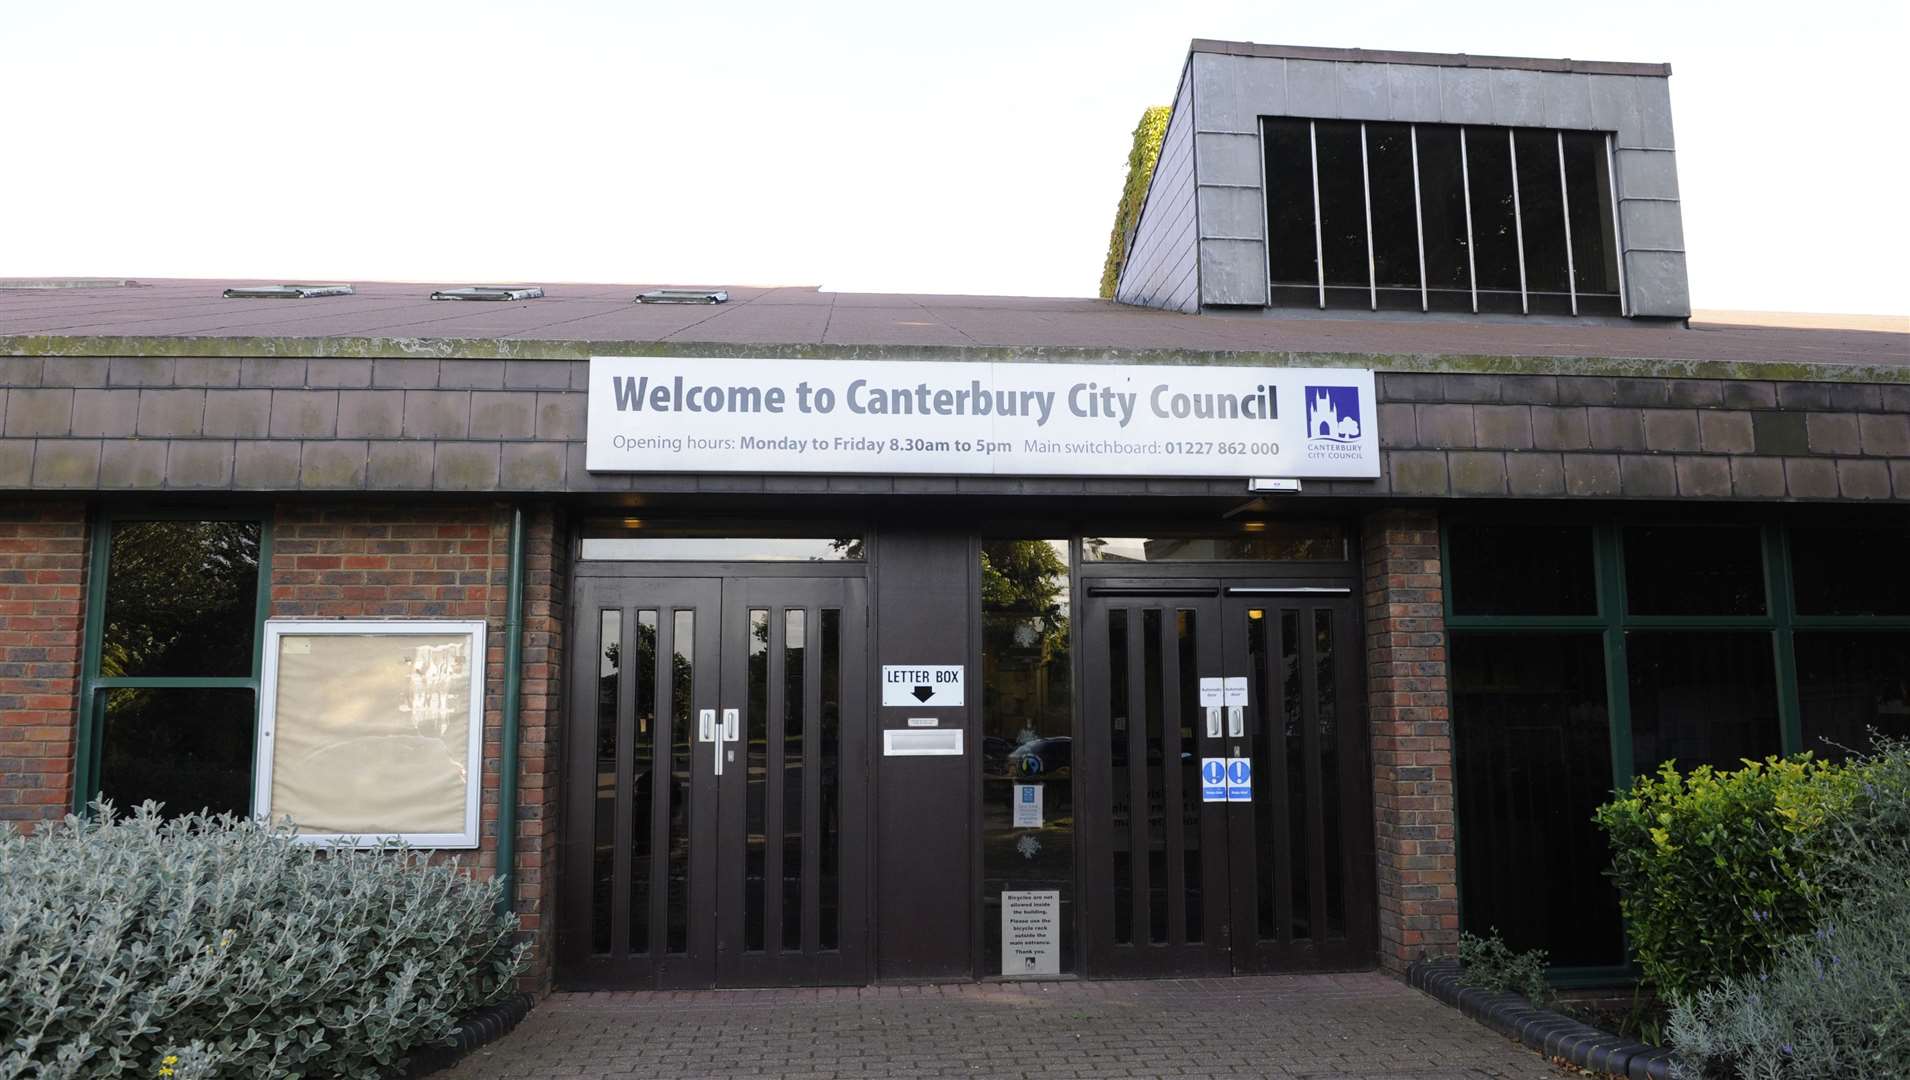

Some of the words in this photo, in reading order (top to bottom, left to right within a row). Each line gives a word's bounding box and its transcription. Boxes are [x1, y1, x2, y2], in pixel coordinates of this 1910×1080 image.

[612, 375, 786, 413] Welcome
[796, 381, 836, 414] to
[846, 379, 1056, 427] Canterbury
[1067, 382, 1137, 428] City
[1150, 384, 1279, 420] Council
[612, 434, 682, 453] Opening
[687, 434, 735, 450] hours:
[740, 435, 808, 453] Monday
[812, 437, 829, 450] to
[833, 436, 885, 455] Friday
[889, 437, 950, 452] 8.30am
[954, 439, 972, 452] to
[976, 439, 1012, 455] 5pm
[1024, 440, 1061, 453] Main
[1064, 440, 1162, 455] switchboard:
[1165, 442, 1213, 455] 01227
[1218, 442, 1246, 455] 862
[1251, 442, 1280, 456] 000
[1307, 452, 1325, 460] CITY
[1328, 452, 1363, 460] COUNCIL
[887, 670, 930, 683] LETTER
[936, 670, 959, 683] BOX
